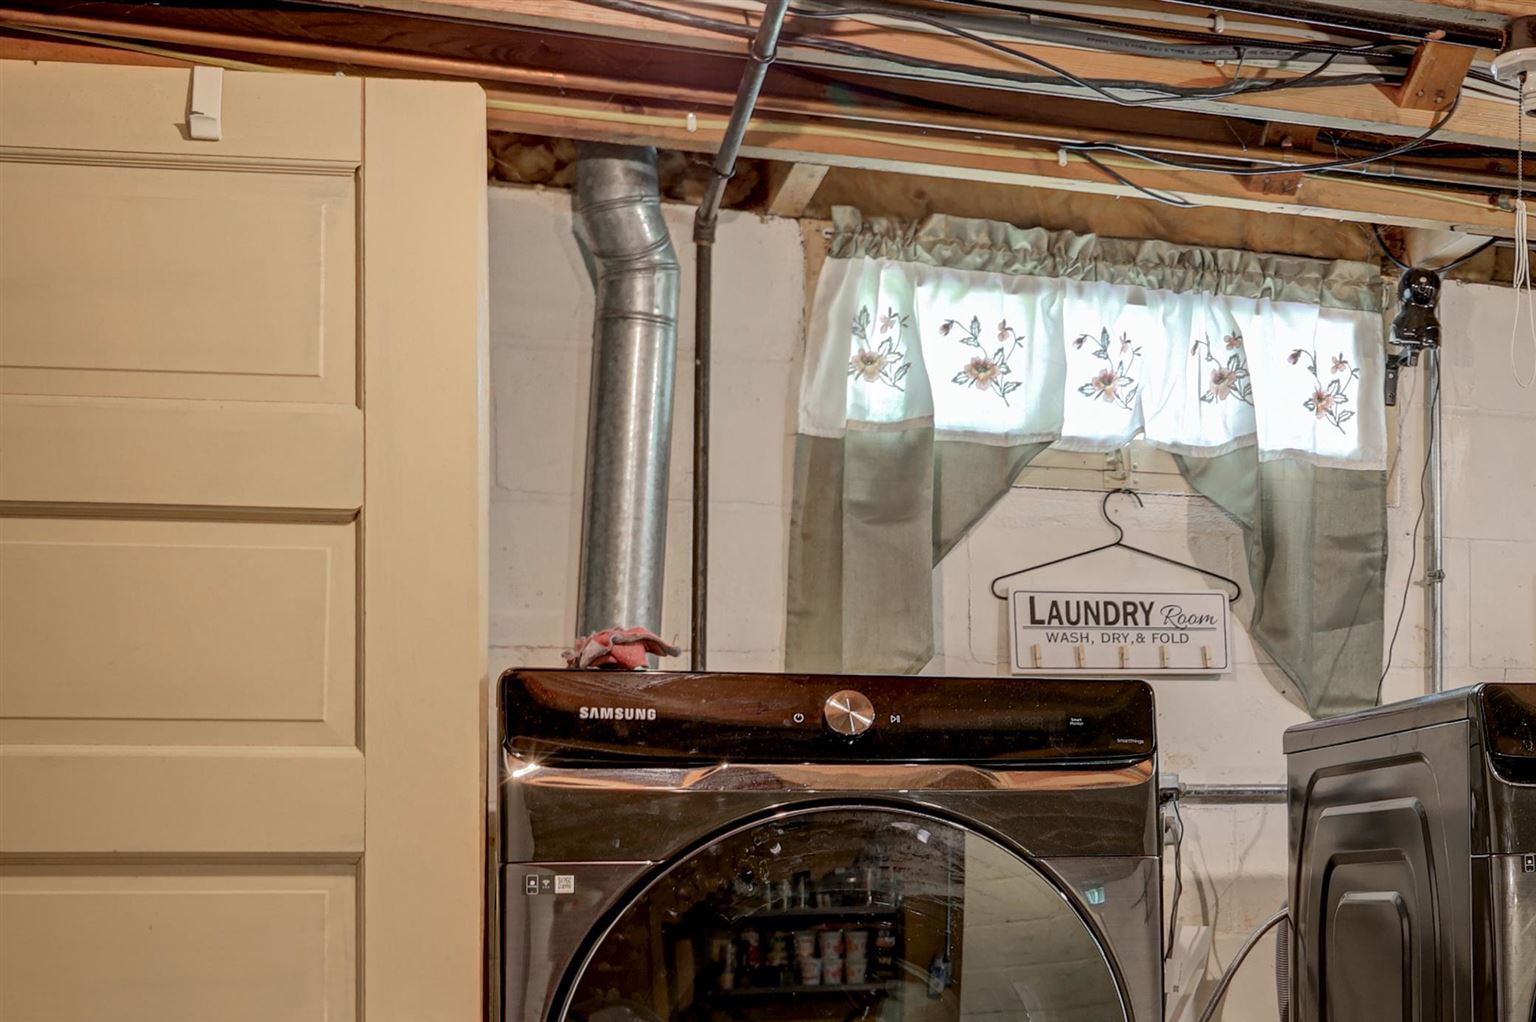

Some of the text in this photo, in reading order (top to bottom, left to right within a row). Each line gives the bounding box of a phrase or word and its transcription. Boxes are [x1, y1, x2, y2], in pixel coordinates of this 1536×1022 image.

[1028, 595, 1218, 630] LAUNDRY Room
[1046, 632, 1095, 645] WASH,
[1152, 633, 1190, 644] FOLD
[579, 706, 657, 720] SAMSUNG
